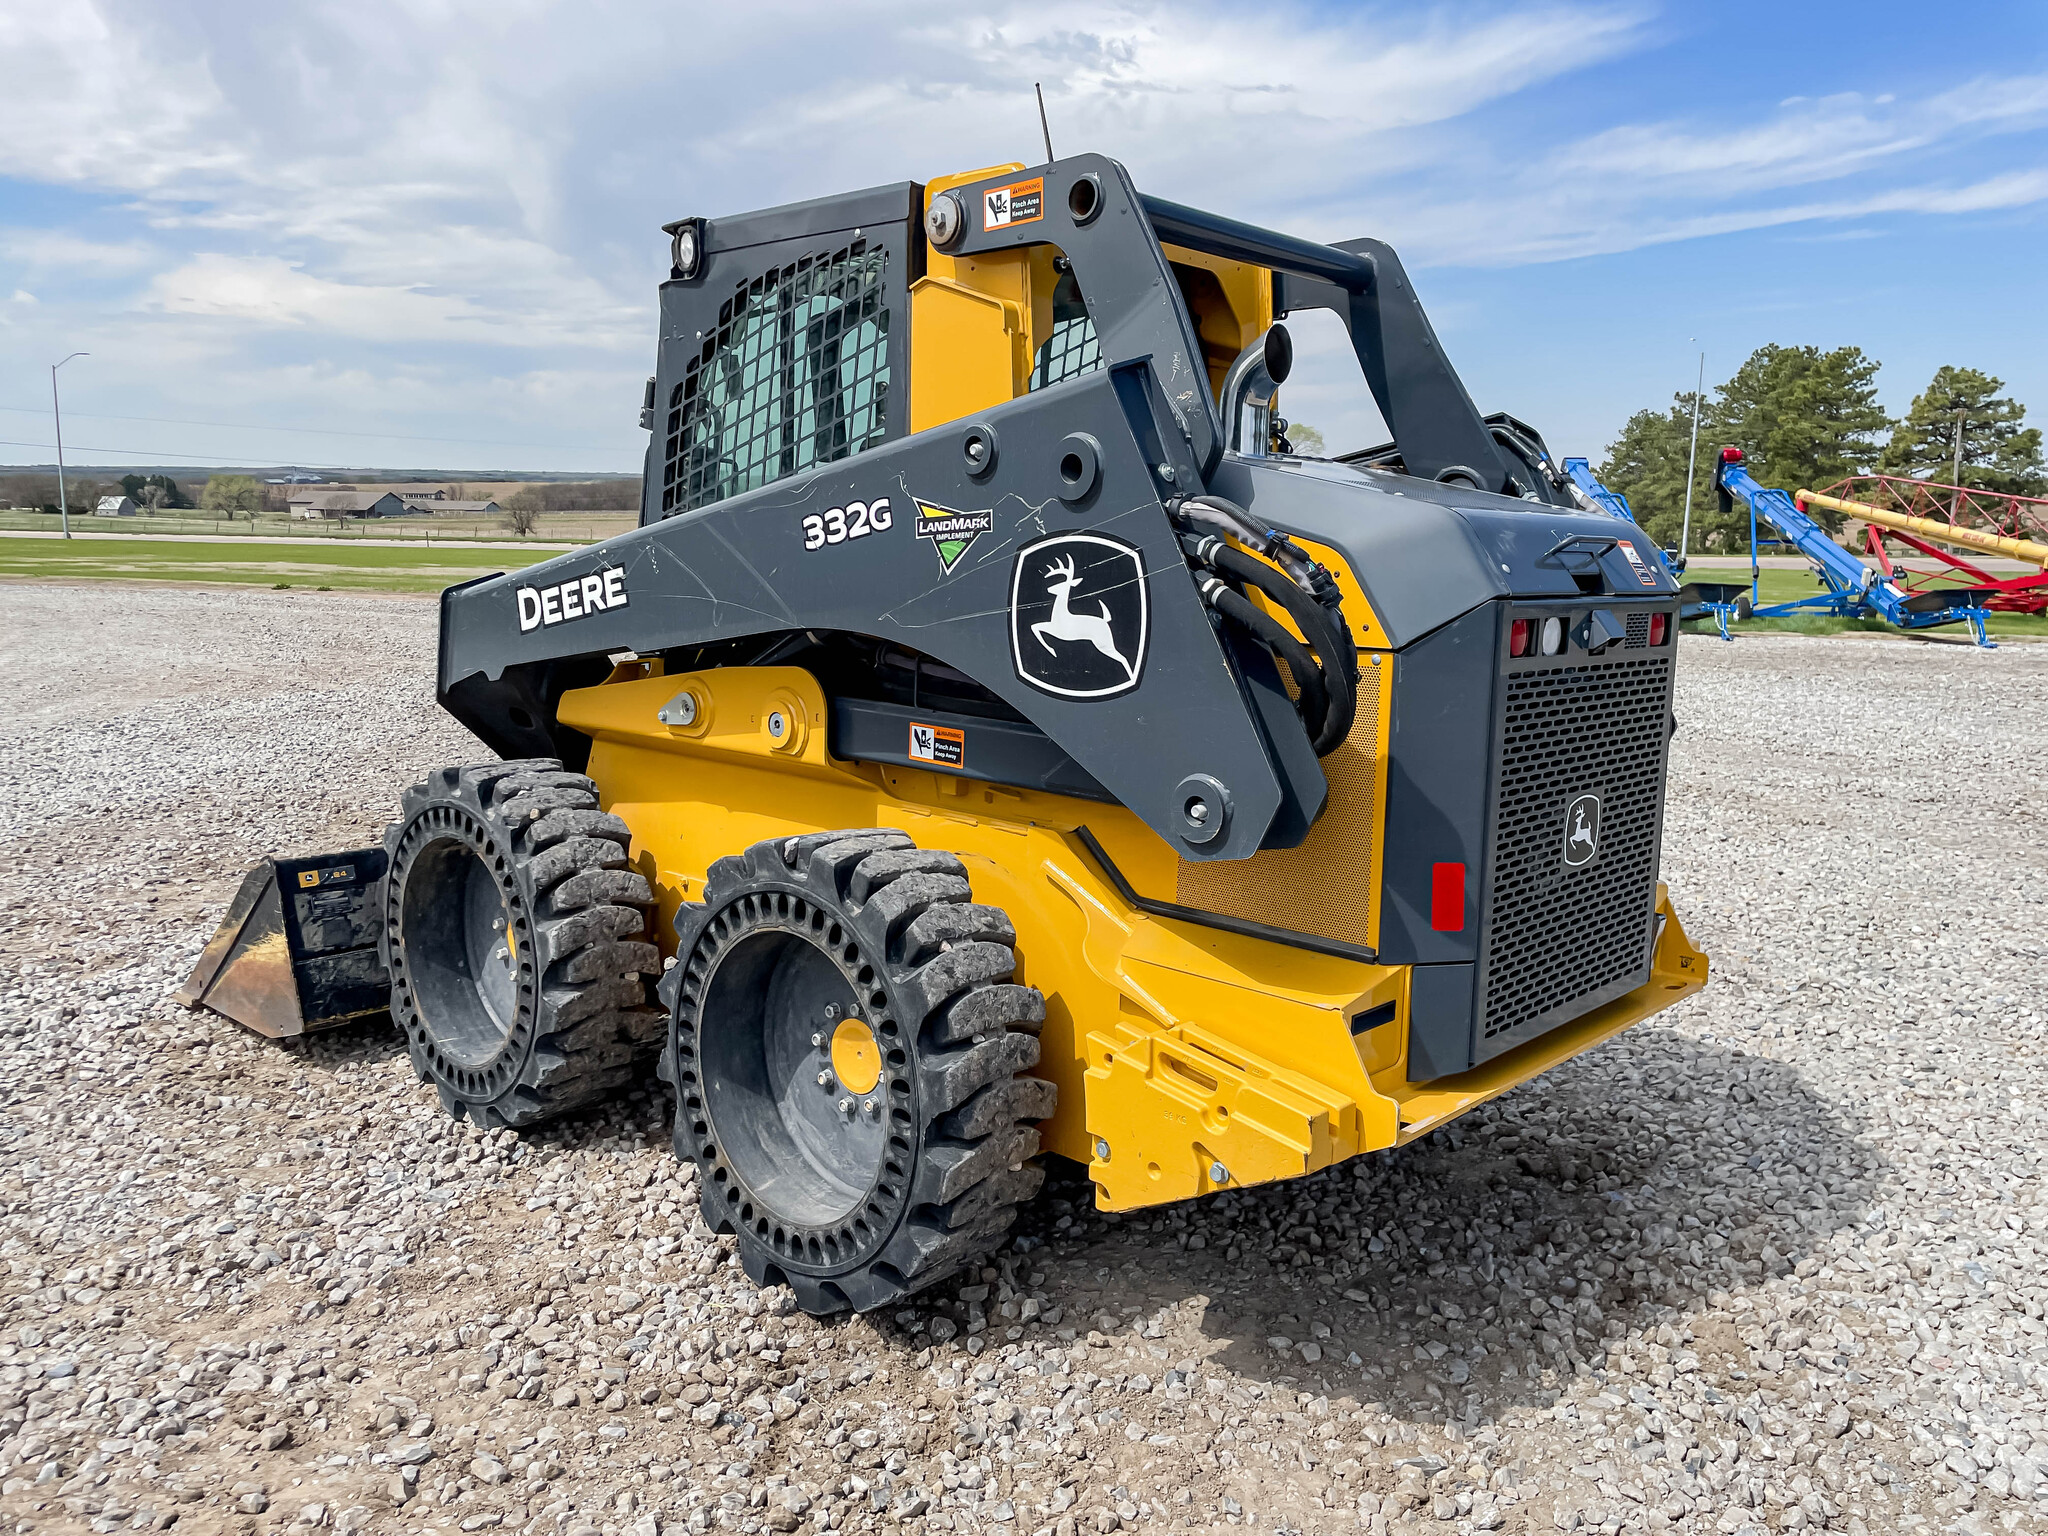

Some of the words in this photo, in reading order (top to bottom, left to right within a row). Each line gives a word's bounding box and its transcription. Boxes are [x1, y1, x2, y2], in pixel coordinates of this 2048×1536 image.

[1017, 183, 1040, 192] WARNING
[1012, 200, 1026, 209] Pinch
[1027, 198, 1039, 206] Area
[802, 498, 892, 551] 332G
[918, 517, 990, 533] LANDMARK
[935, 531, 975, 541] IMPLEMENT
[517, 567, 627, 631] DEERE
[935, 743, 948, 751] Pinch
